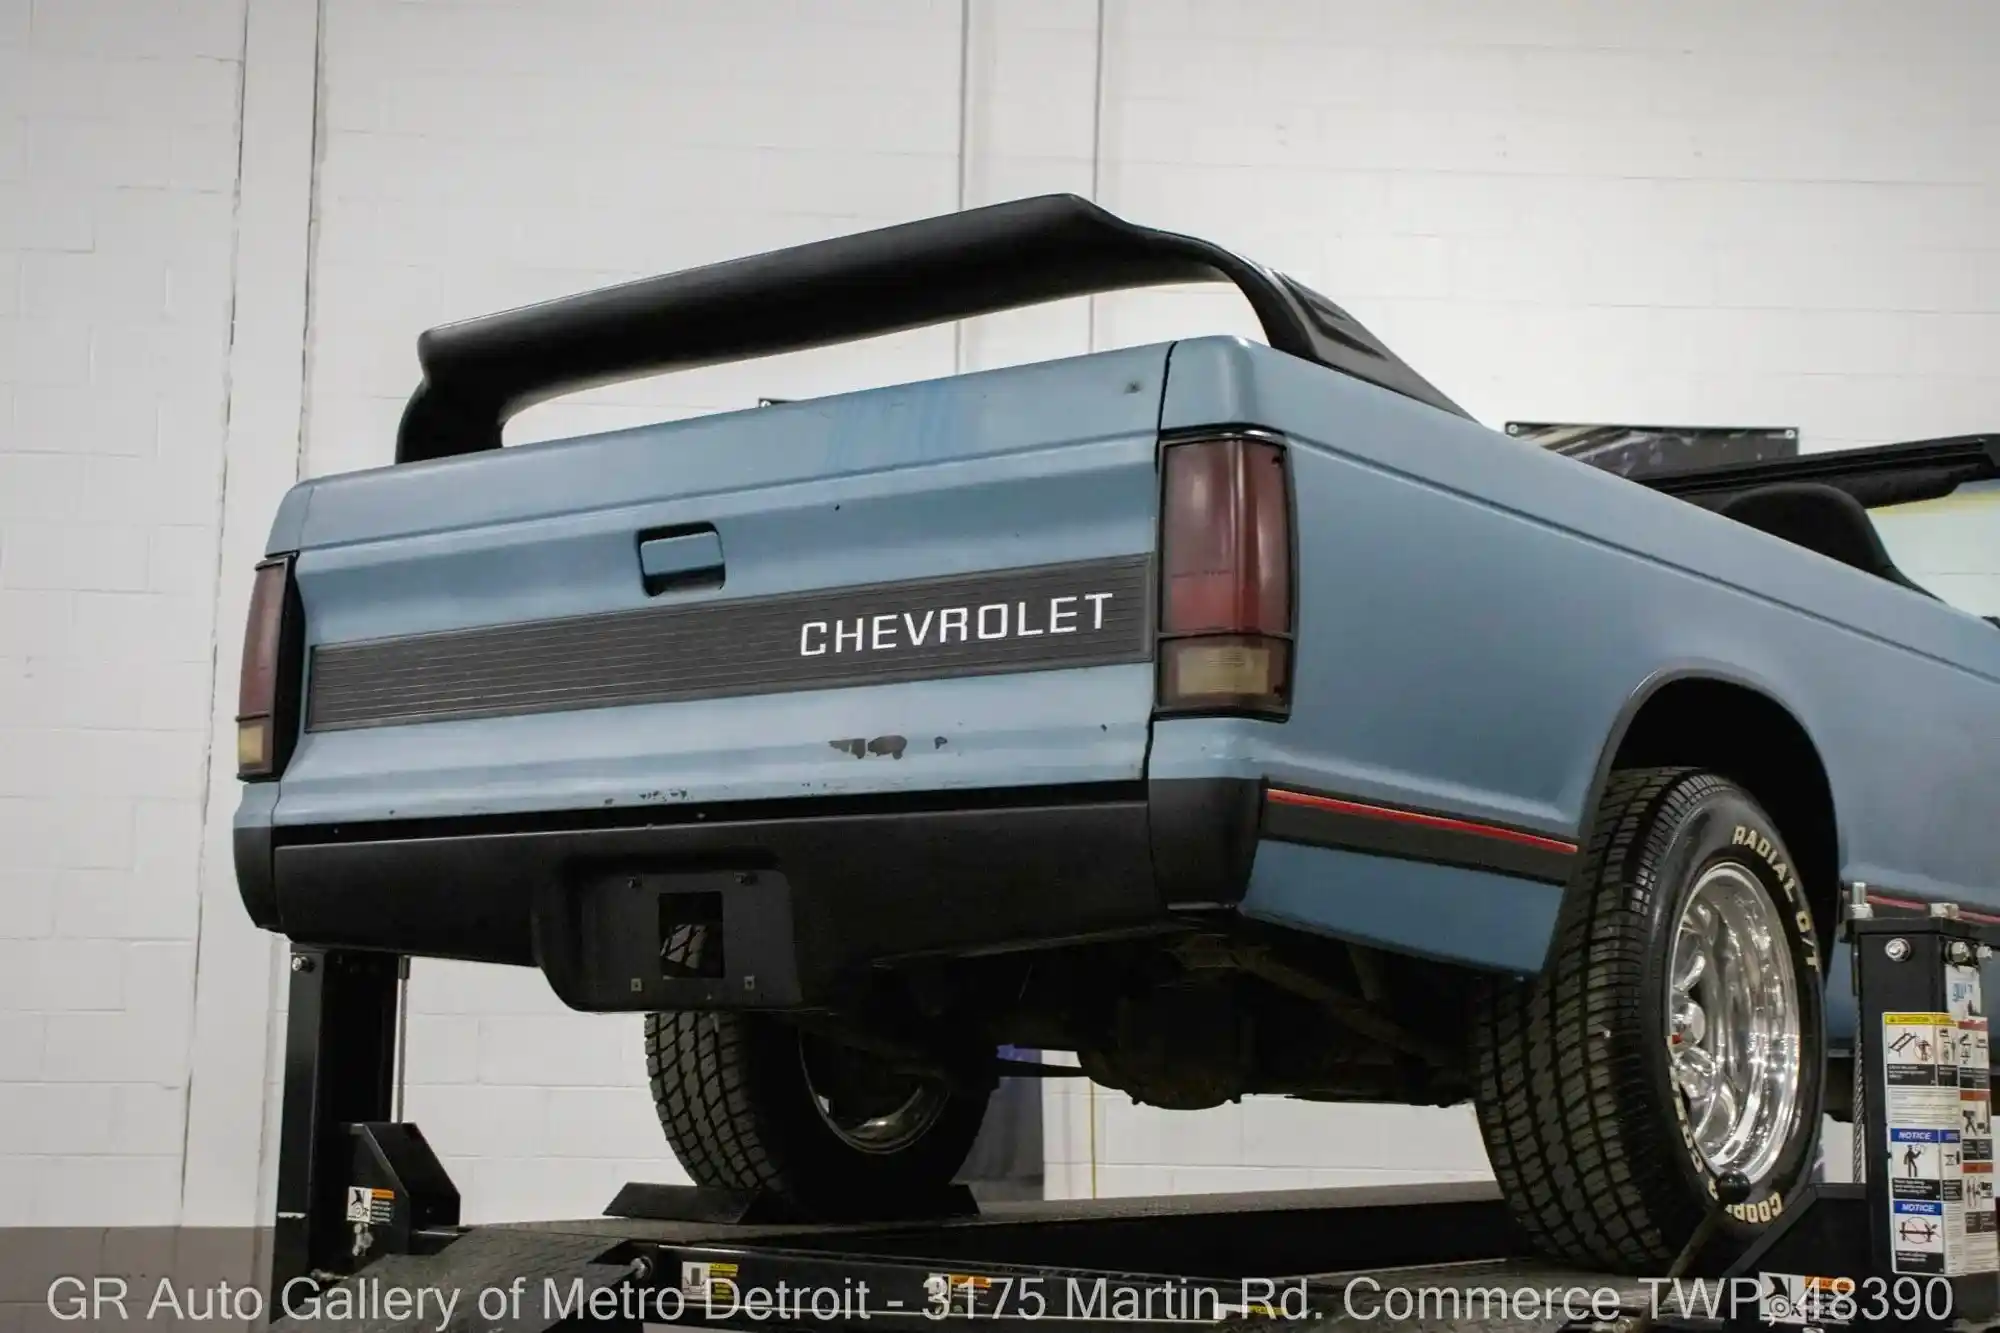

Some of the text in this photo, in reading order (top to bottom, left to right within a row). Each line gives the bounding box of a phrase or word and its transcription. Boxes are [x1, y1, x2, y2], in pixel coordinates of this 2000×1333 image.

[800, 592, 1113, 656] CHEVROLET
[1732, 825, 1795, 902] RADIAL
[1898, 1131, 1933, 1140] NOTICE
[1901, 1203, 1936, 1212] NOTICE
